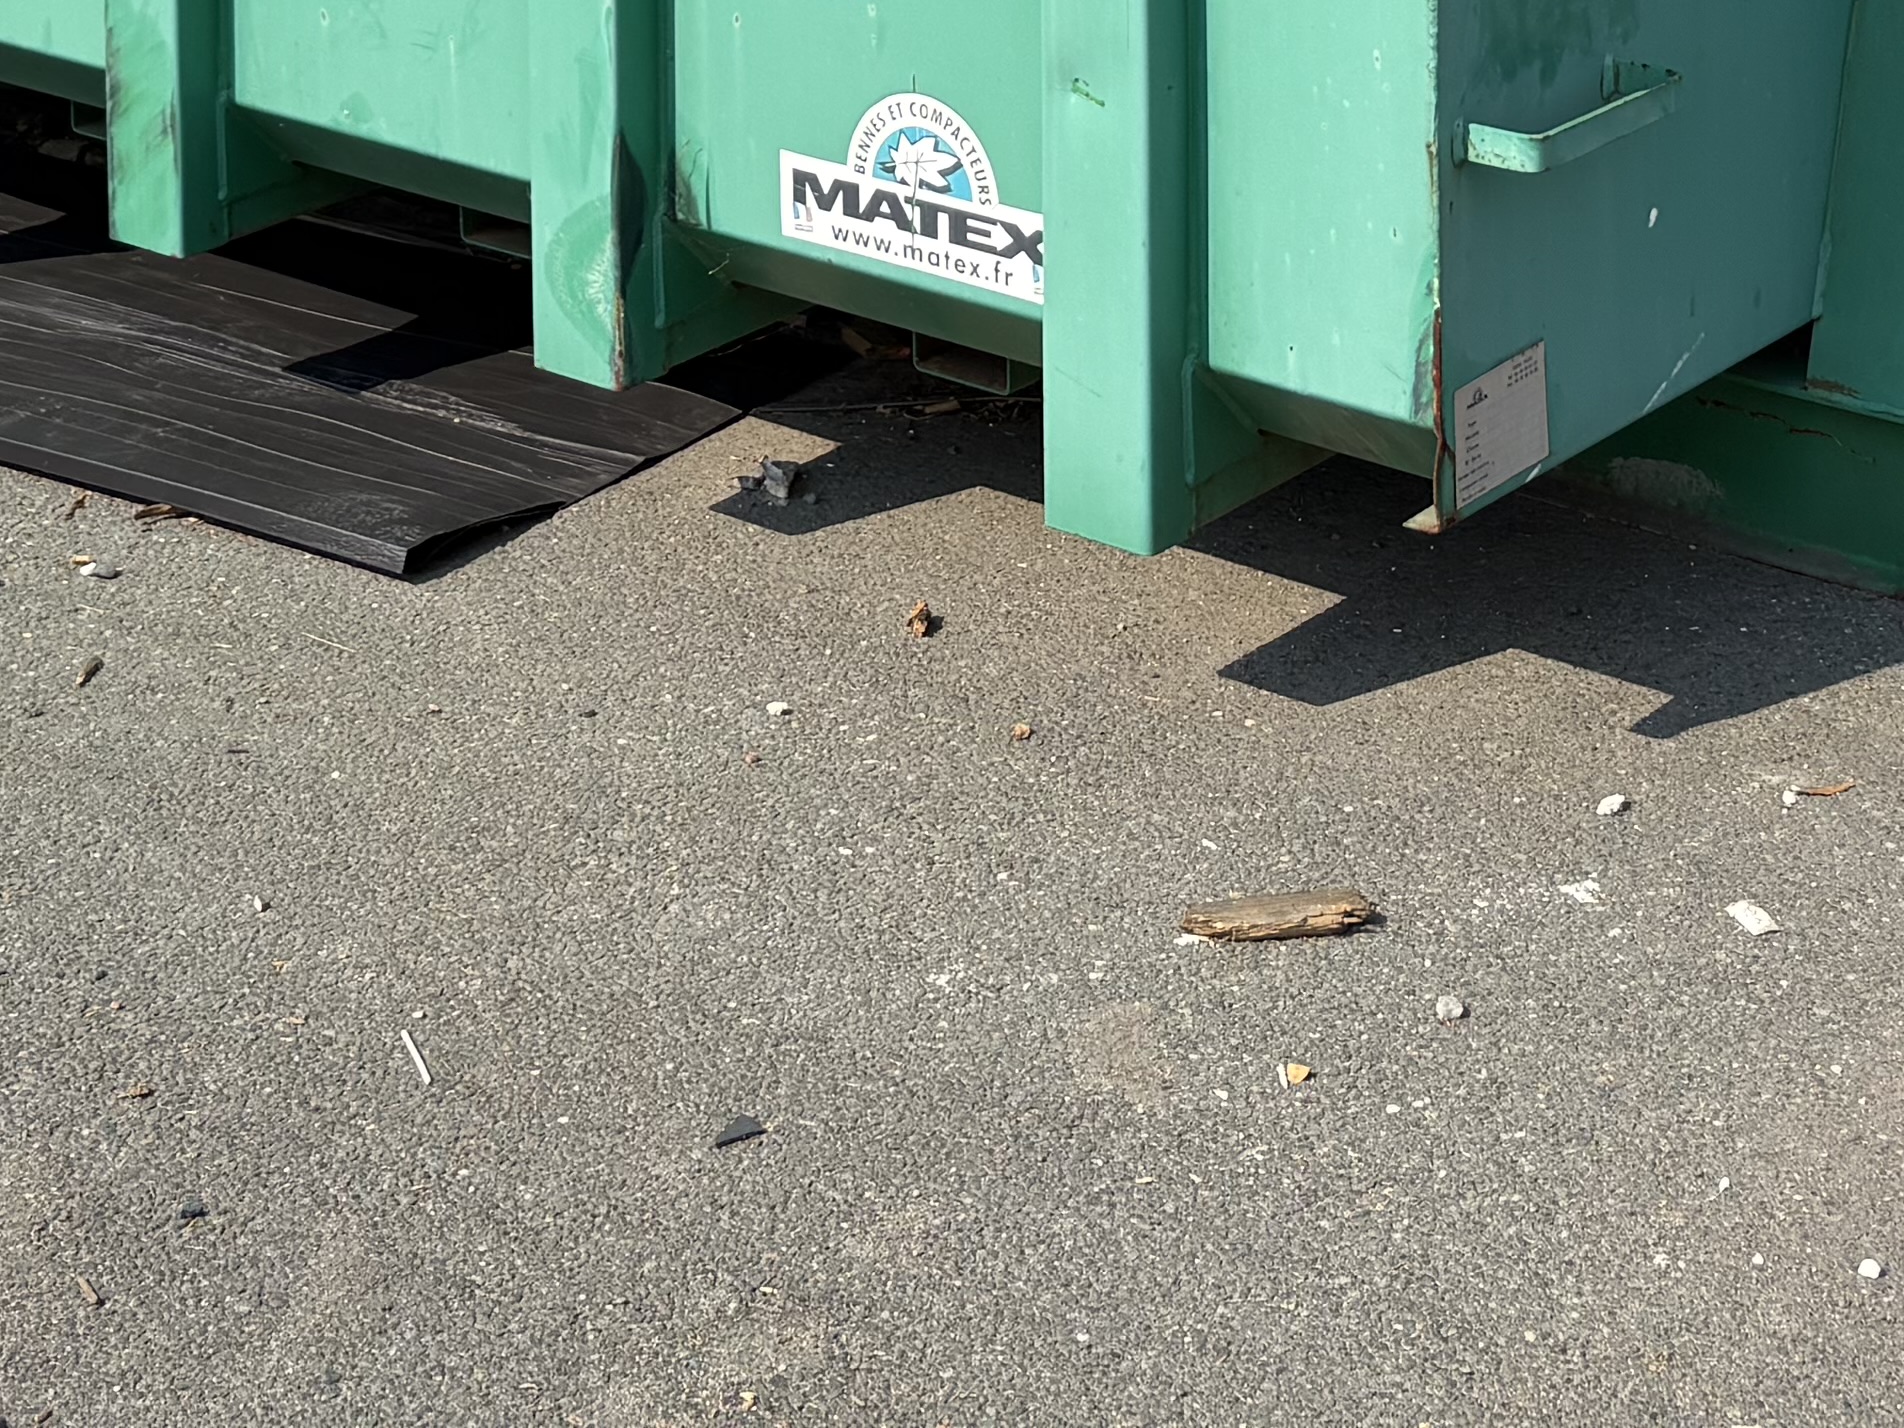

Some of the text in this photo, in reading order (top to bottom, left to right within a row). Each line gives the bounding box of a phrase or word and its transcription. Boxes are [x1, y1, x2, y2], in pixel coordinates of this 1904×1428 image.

[853, 101, 992, 206] BENNES ET COMPACTEURS
[792, 167, 1043, 267] MATEX
[831, 224, 1014, 287] www.matex.fr
